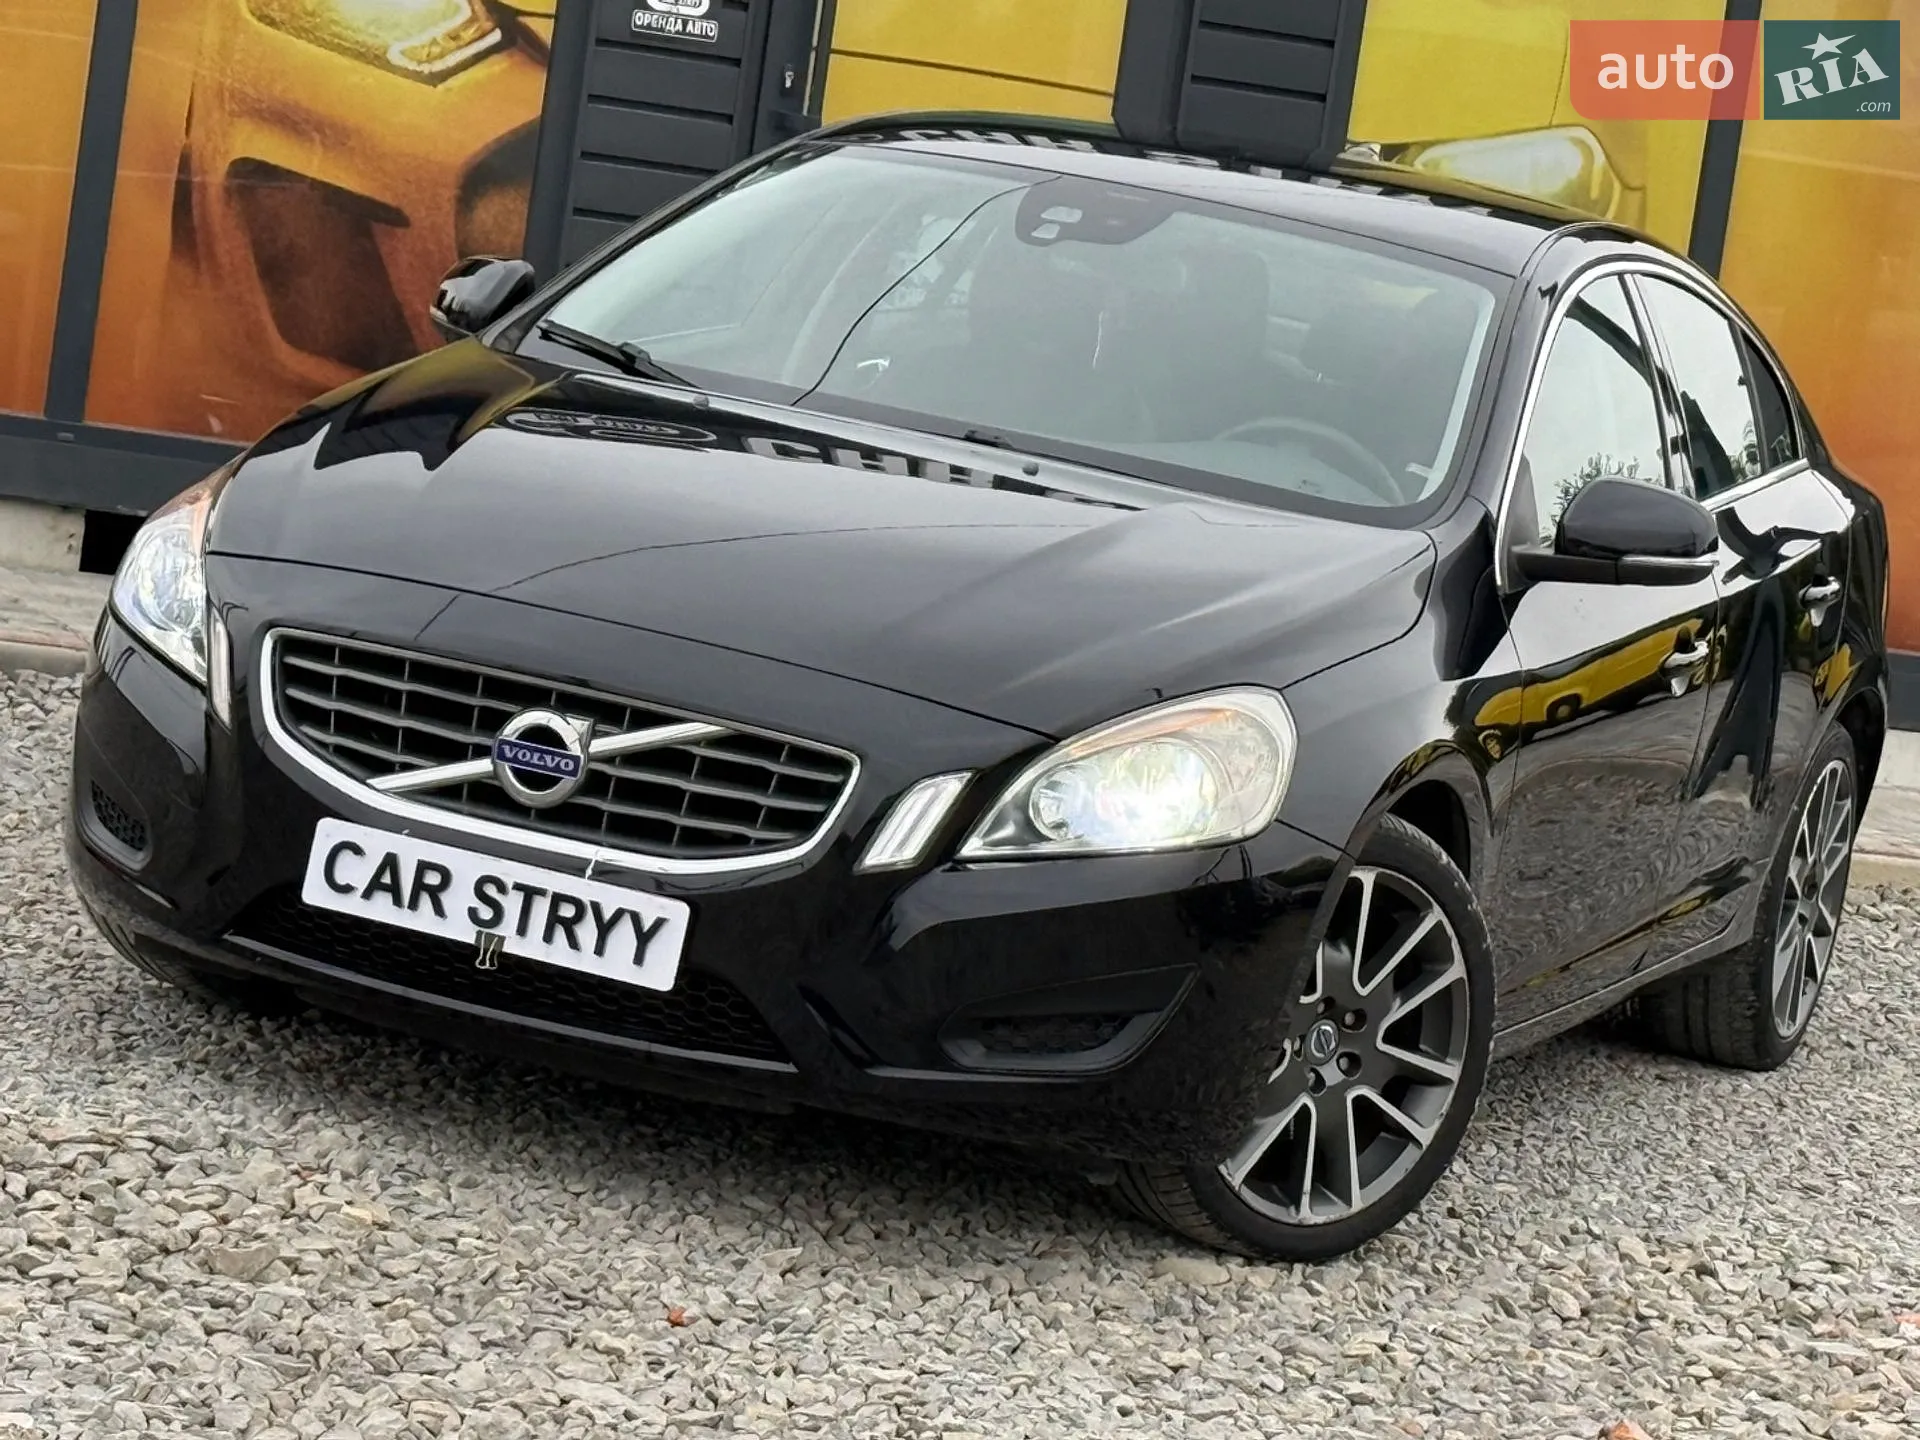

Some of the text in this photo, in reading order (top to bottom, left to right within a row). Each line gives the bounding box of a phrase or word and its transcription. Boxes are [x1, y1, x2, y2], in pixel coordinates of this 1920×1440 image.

[502, 745, 575, 771] VOLVO
[323, 840, 671, 967] CAR STRYY
